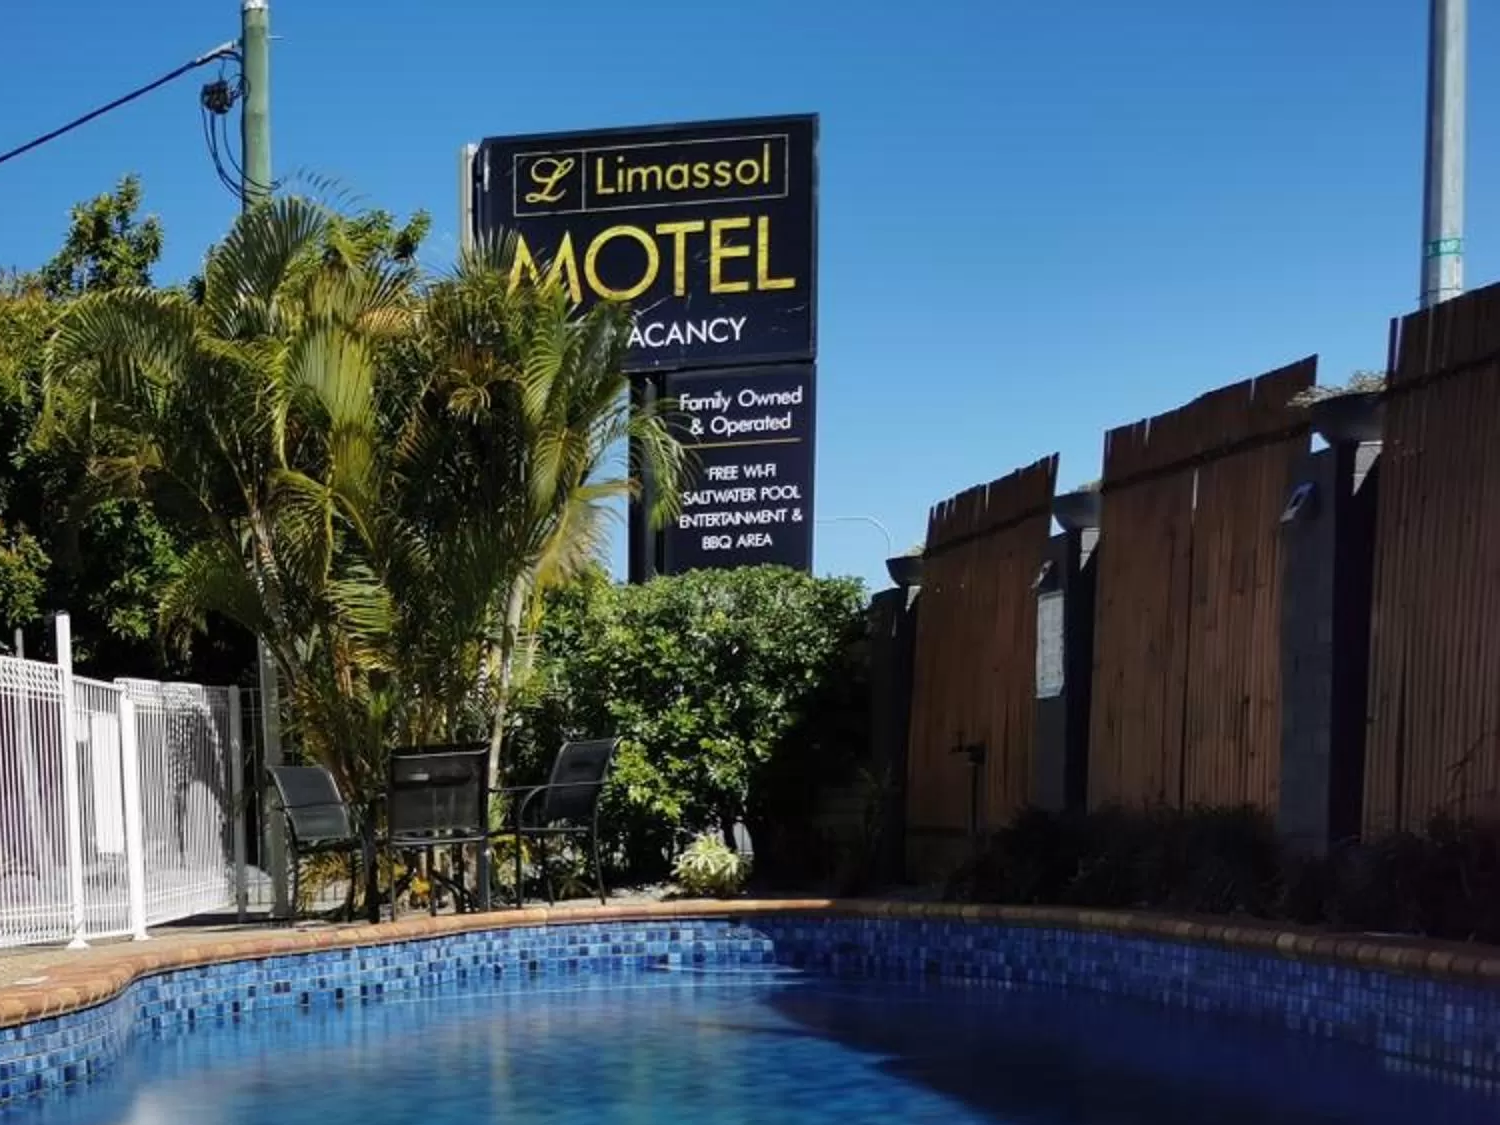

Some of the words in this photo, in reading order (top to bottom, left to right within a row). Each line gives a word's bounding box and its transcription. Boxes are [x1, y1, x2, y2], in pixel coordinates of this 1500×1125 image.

[595, 142, 770, 195] Limassol
[505, 215, 796, 304] MOTEL
[625, 316, 747, 349] ACANCY
[679, 390, 731, 413] Family
[737, 385, 803, 408] Owned
[689, 417, 704, 436] &
[710, 411, 792, 438] Operated
[708, 465, 739, 481] FREE
[742, 463, 777, 479] WI-FI
[683, 487, 757, 506] SALTWATER
[760, 485, 802, 501] POOL
[679, 508, 788, 529] ENTERTAINMENT
[791, 507, 803, 522] &
[701, 535, 733, 551] BBQ
[736, 533, 773, 549] AREA
